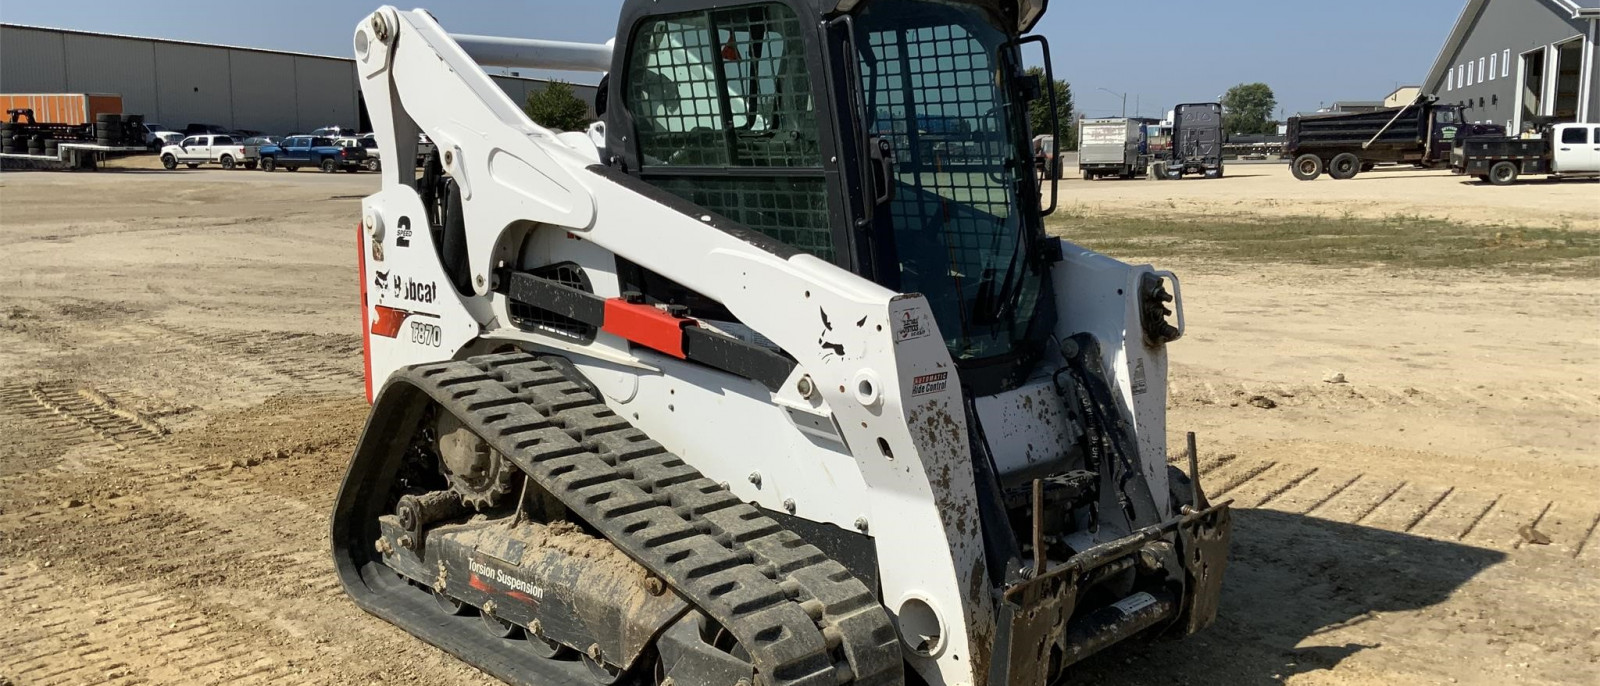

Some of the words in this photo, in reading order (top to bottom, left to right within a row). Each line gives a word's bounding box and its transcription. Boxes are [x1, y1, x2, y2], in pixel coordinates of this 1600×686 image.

[396, 216, 411, 247] 2
[396, 229, 413, 237] SPEED
[411, 321, 441, 347] T870
[912, 383, 925, 394] Ride
[926, 380, 947, 392] Control
[914, 373, 947, 383] AUTOMATIC
[468, 557, 495, 579] Torsion
[497, 569, 543, 598] Suspension
